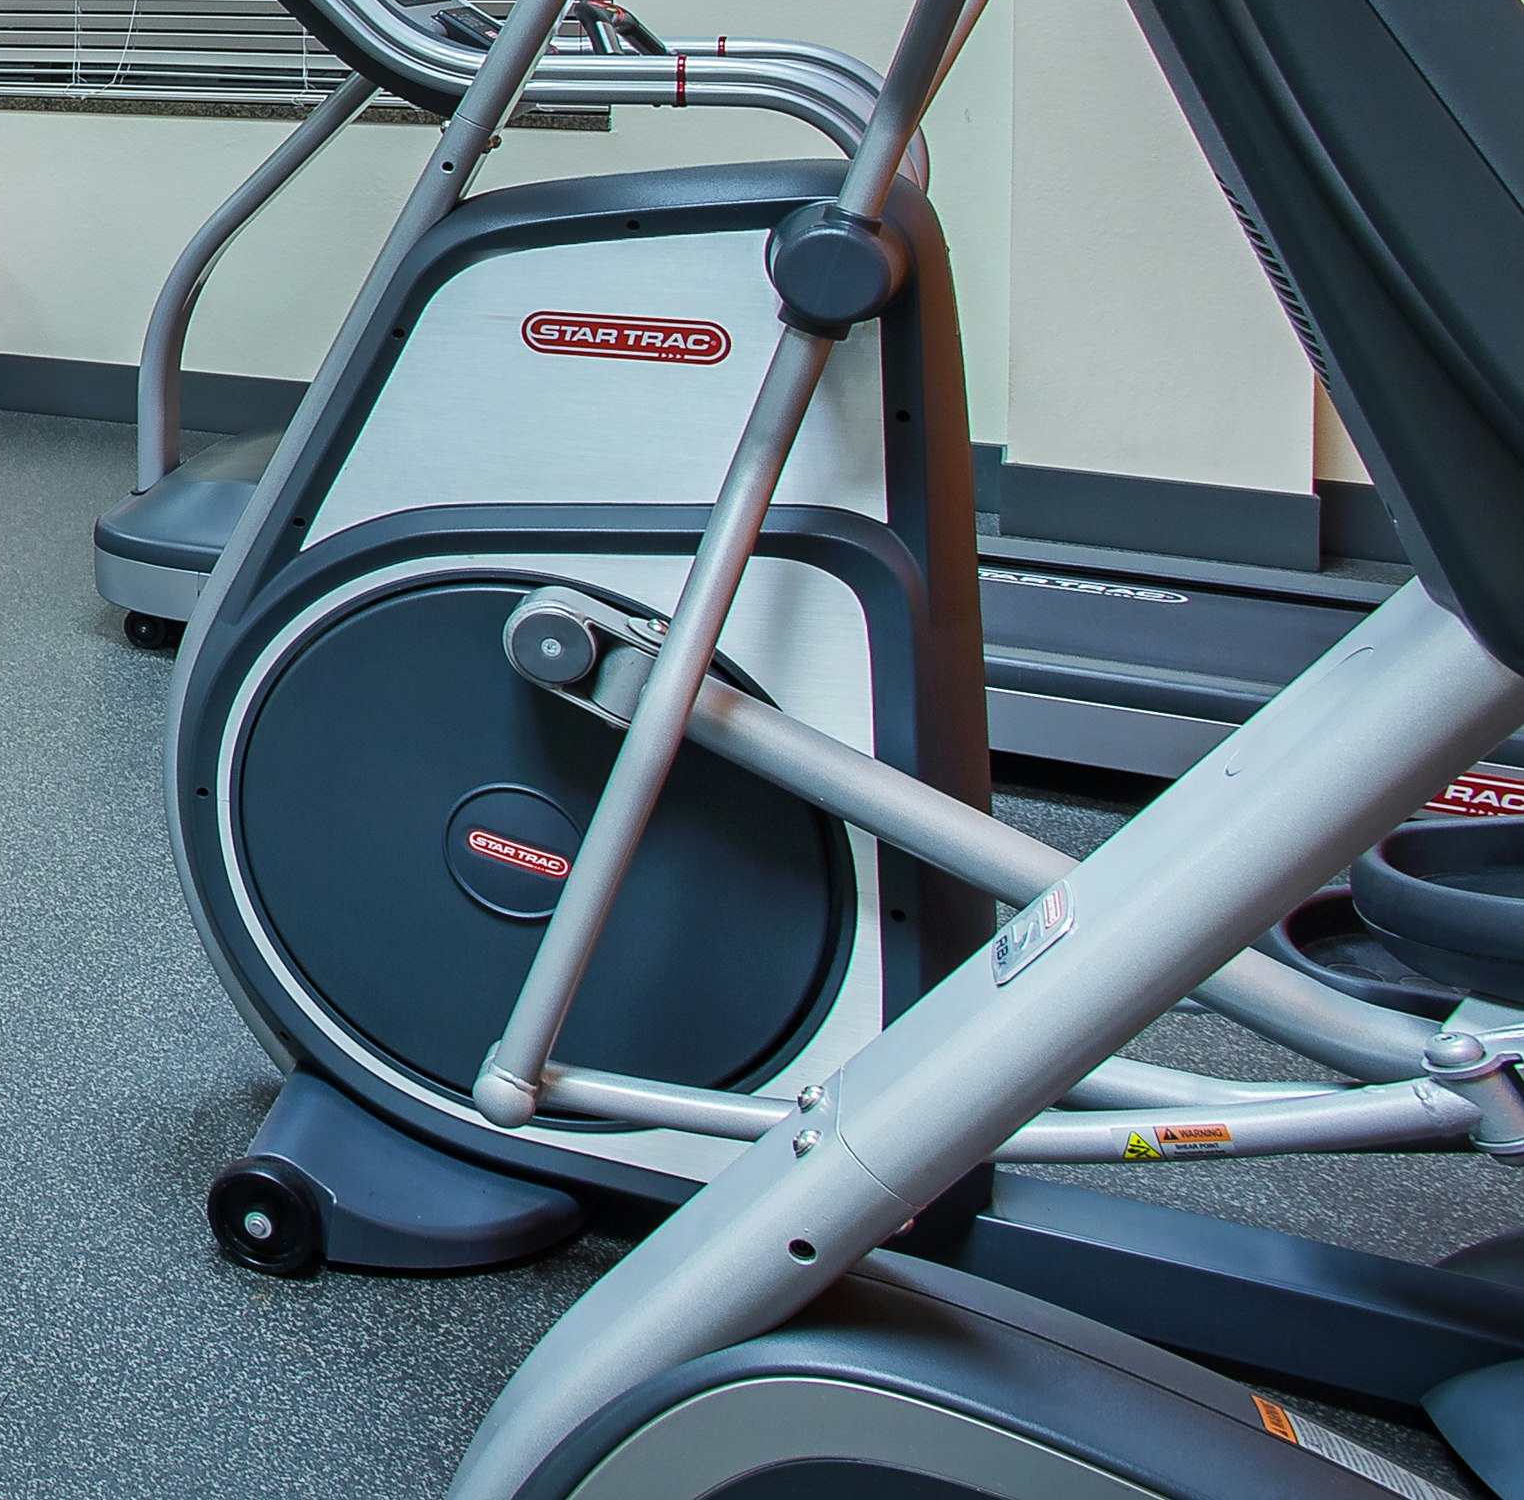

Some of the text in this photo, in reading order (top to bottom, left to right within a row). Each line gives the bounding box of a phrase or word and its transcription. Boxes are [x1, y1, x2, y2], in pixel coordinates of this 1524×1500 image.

[537, 324, 711, 351] STAR TRAC
[978, 571, 1166, 599] TAR TRAC
[1443, 783, 1524, 811] RAC
[475, 836, 561, 870] STAR TRAC
[1178, 1128, 1223, 1138] WARNING
